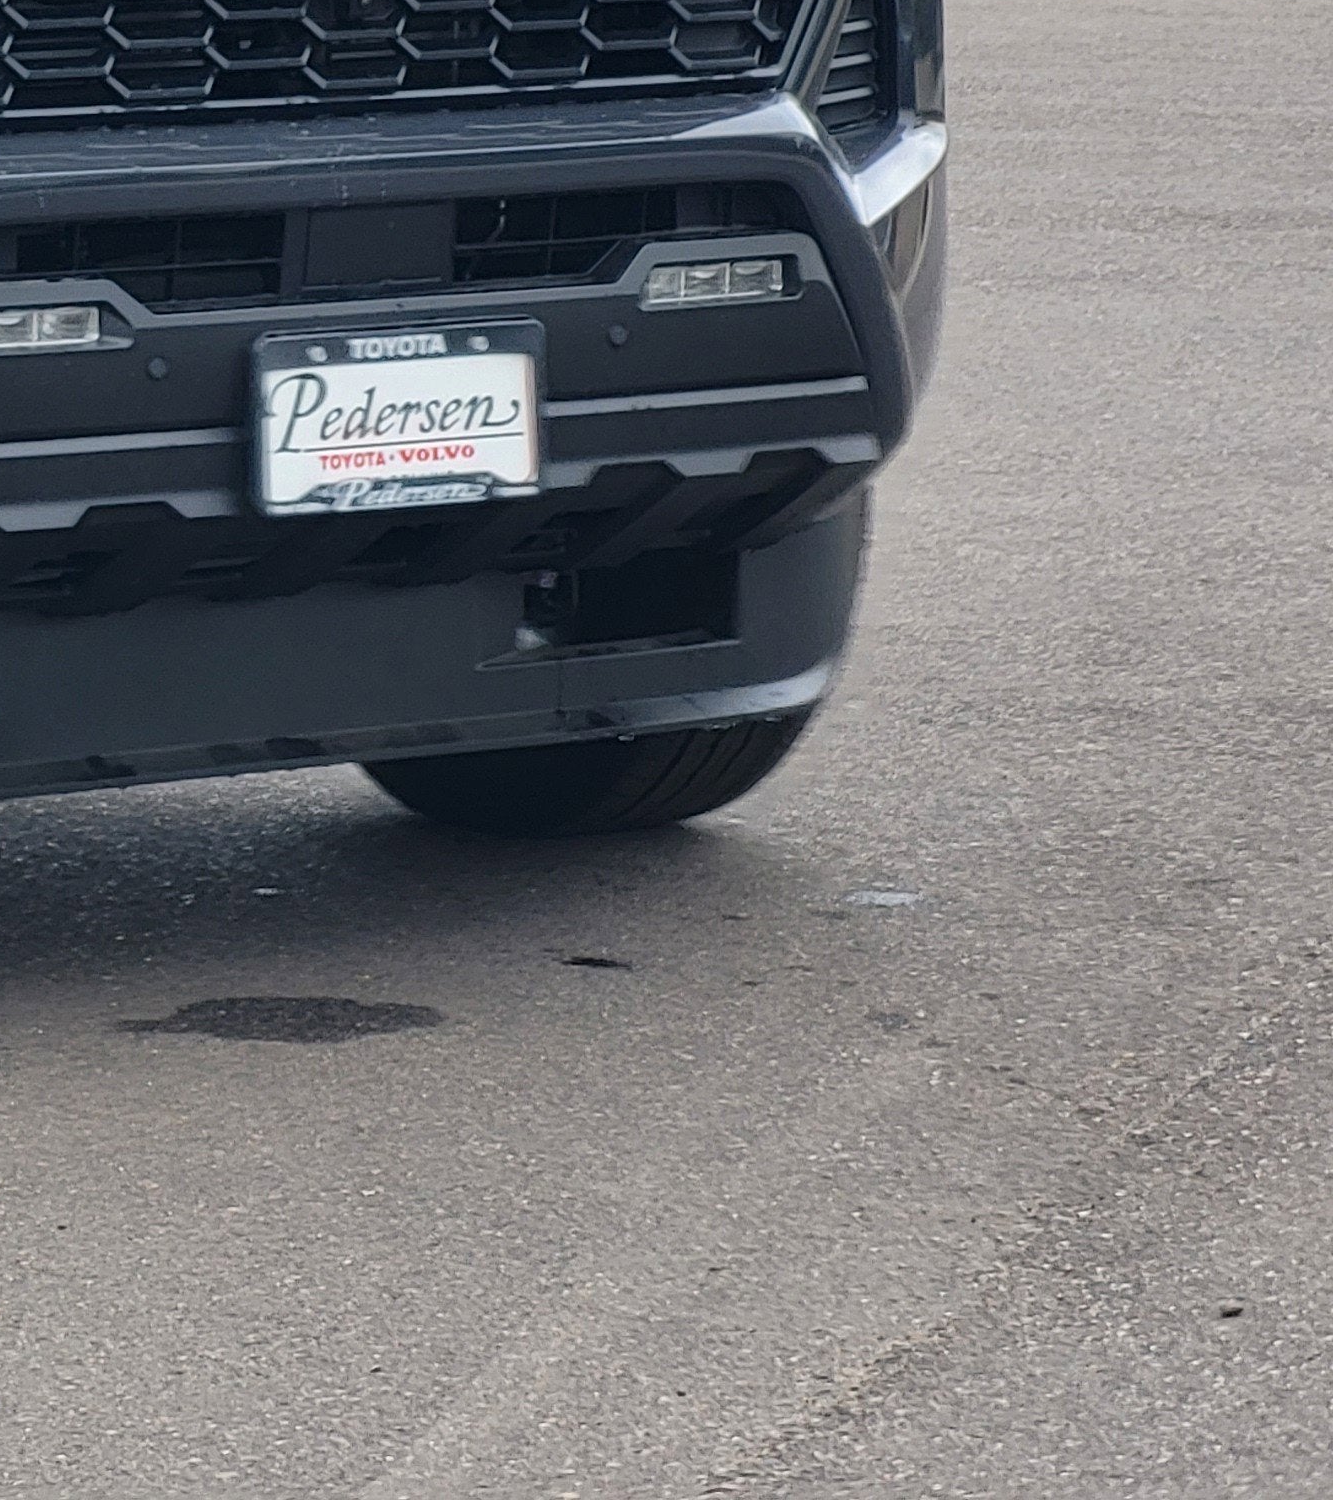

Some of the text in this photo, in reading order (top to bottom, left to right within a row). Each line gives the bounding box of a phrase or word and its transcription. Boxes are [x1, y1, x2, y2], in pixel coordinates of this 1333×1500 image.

[346, 333, 448, 360] TOYOTA
[265, 373, 520, 454] Pedersen
[319, 444, 475, 471] TOYOTA VOLVO
